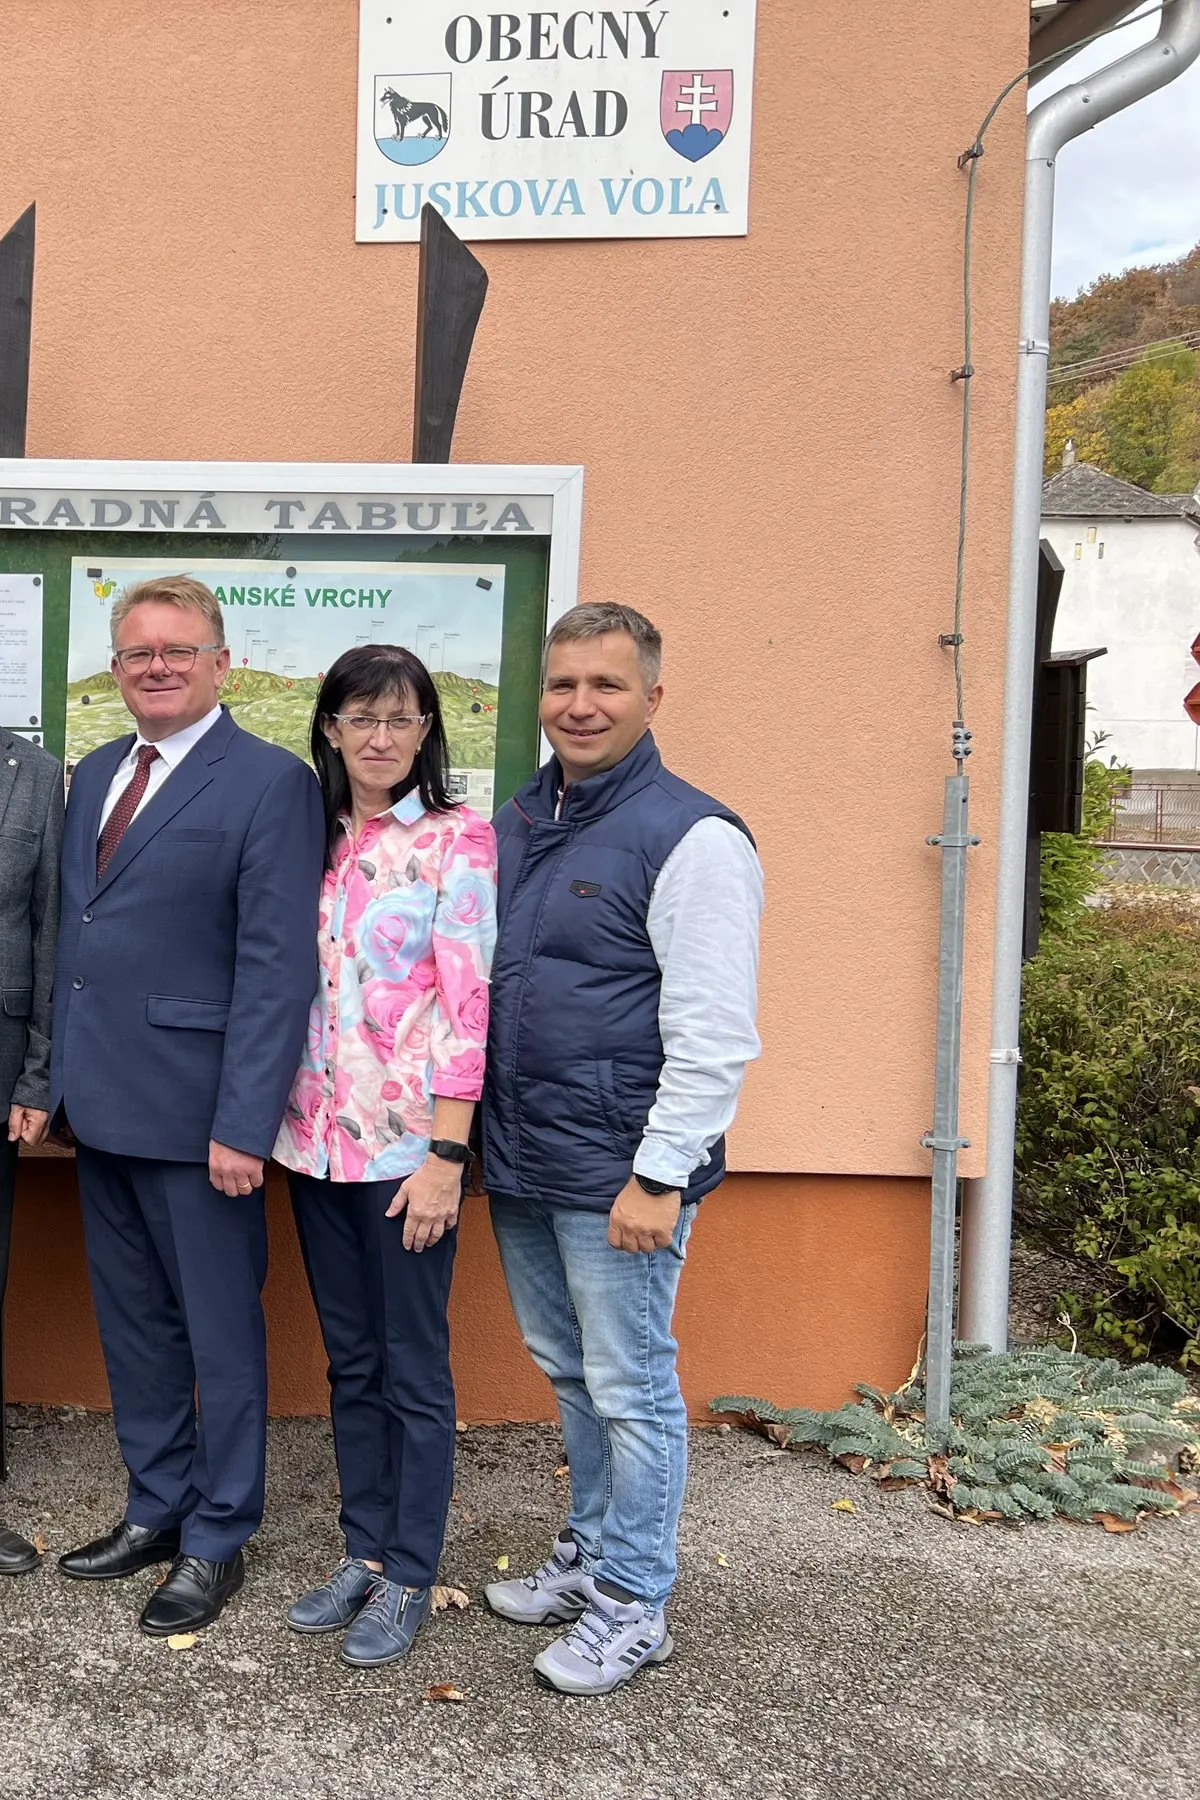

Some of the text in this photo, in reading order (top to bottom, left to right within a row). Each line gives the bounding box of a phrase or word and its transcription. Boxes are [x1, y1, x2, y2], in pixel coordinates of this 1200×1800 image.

[444, 0, 669, 64] OBECNÝ
[479, 75, 628, 140] ÚRAD
[373, 175, 729, 229] JUSKOVA VOĽA
[264, 500, 535, 532] TABUĽA
[214, 583, 393, 609] ANSKÉ VRCHY
